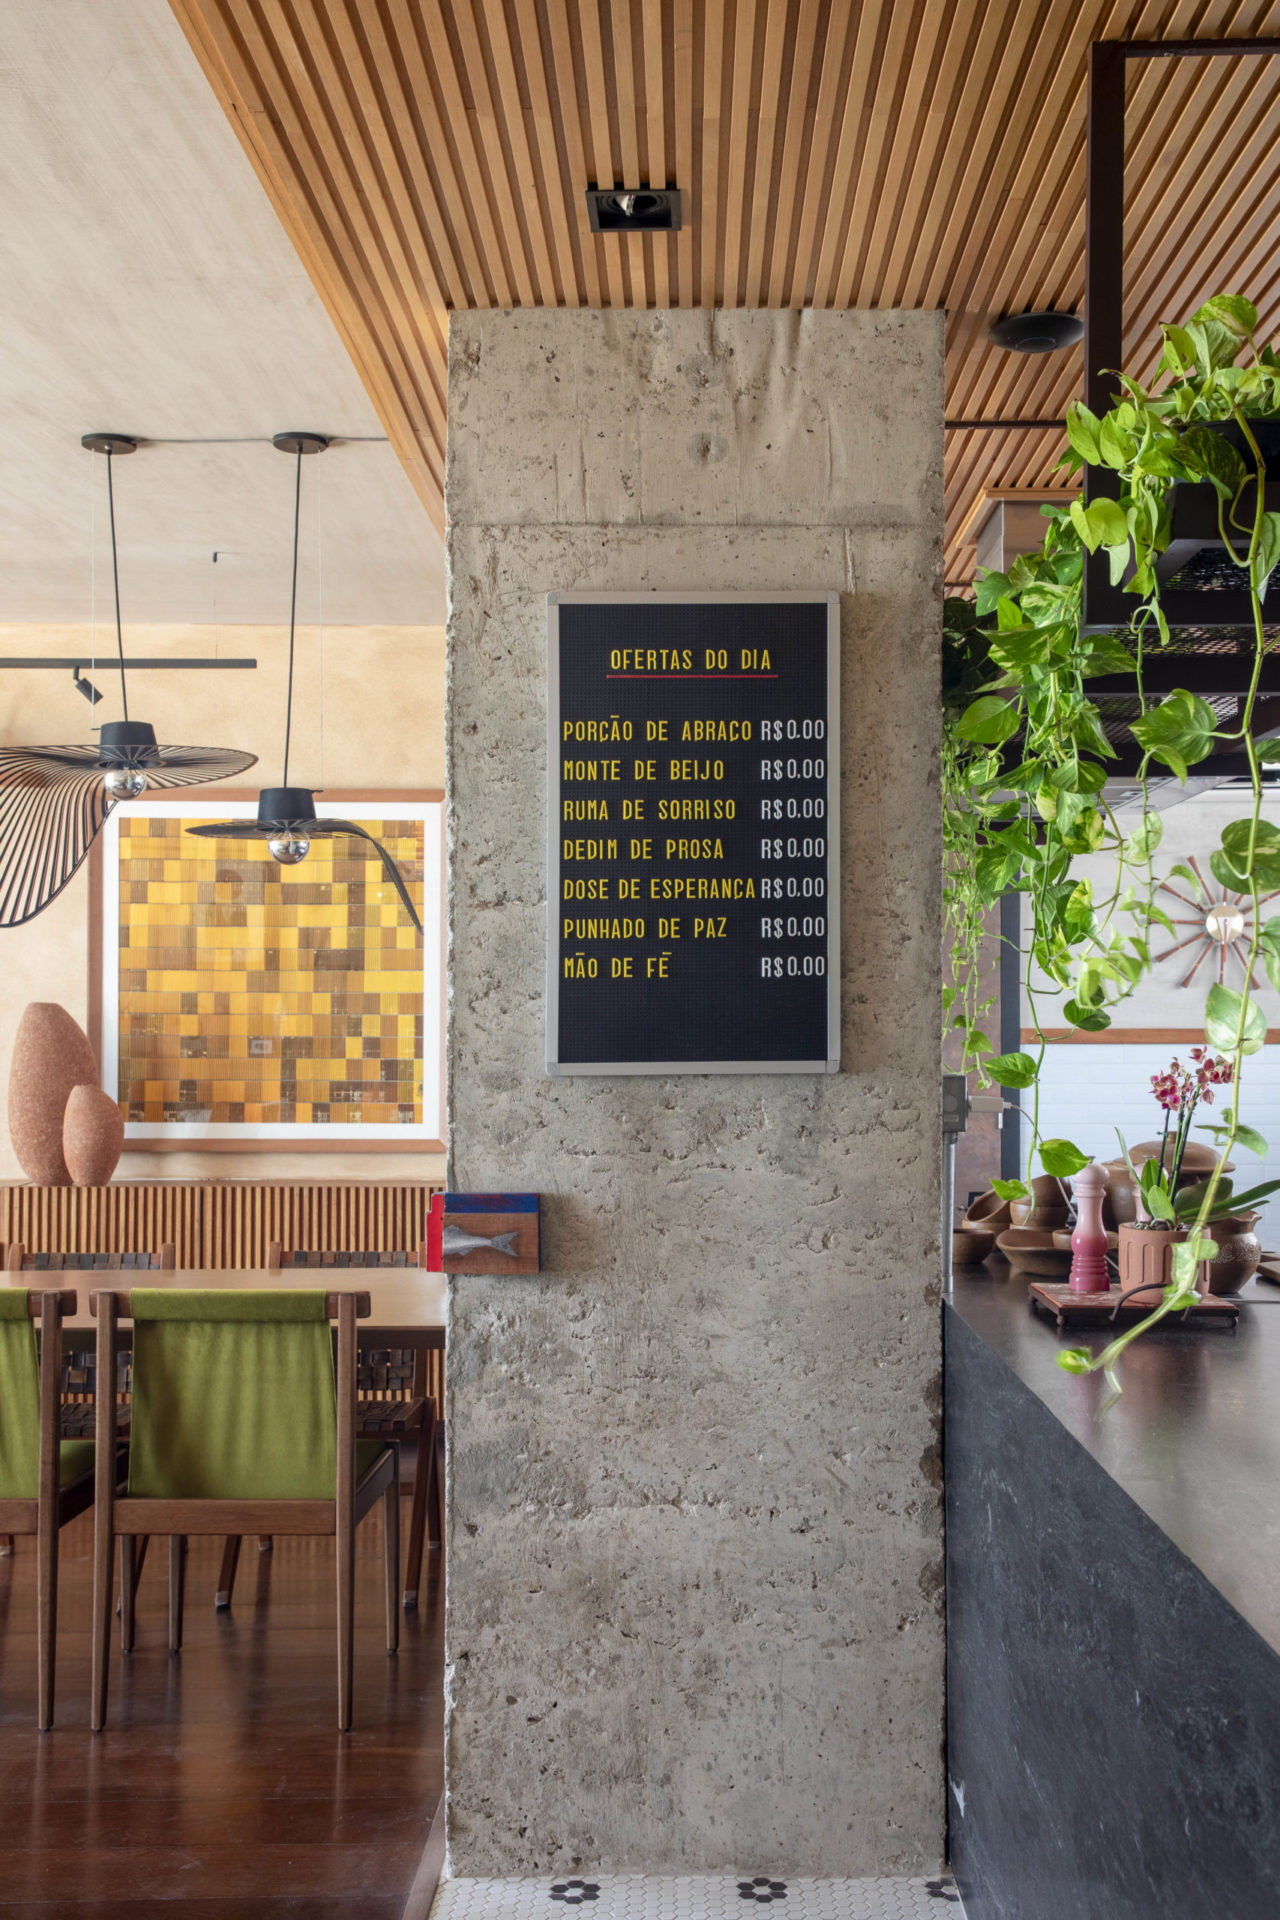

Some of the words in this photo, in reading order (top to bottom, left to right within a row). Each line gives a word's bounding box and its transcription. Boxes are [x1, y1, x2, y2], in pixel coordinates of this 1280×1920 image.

[610, 649, 692, 670] OFERTAS
[705, 649, 728, 670] DO
[741, 649, 771, 670] DIA
[646, 720, 669, 742] DE
[681, 720, 752, 742] ABRAÇO
[563, 759, 621, 781] MONTE
[634, 759, 657, 781] DE
[670, 759, 724, 781] BEIJO
[563, 799, 609, 821] RUMA
[622, 799, 645, 821] DE
[658, 799, 736, 820] SORRISO
[563, 838, 618, 860] DEDIM
[630, 838, 653, 860] DE
[666, 838, 724, 860] PROSA
[563, 878, 609, 900] DOSE
[618, 878, 641, 900] DE
[650, 877, 756, 900] ESPERANÇA
[563, 917, 646, 939] PUNHADO
[658, 917, 681, 939] DE
[694, 917, 727, 939] PAZ
[611, 957, 633, 978] DE
